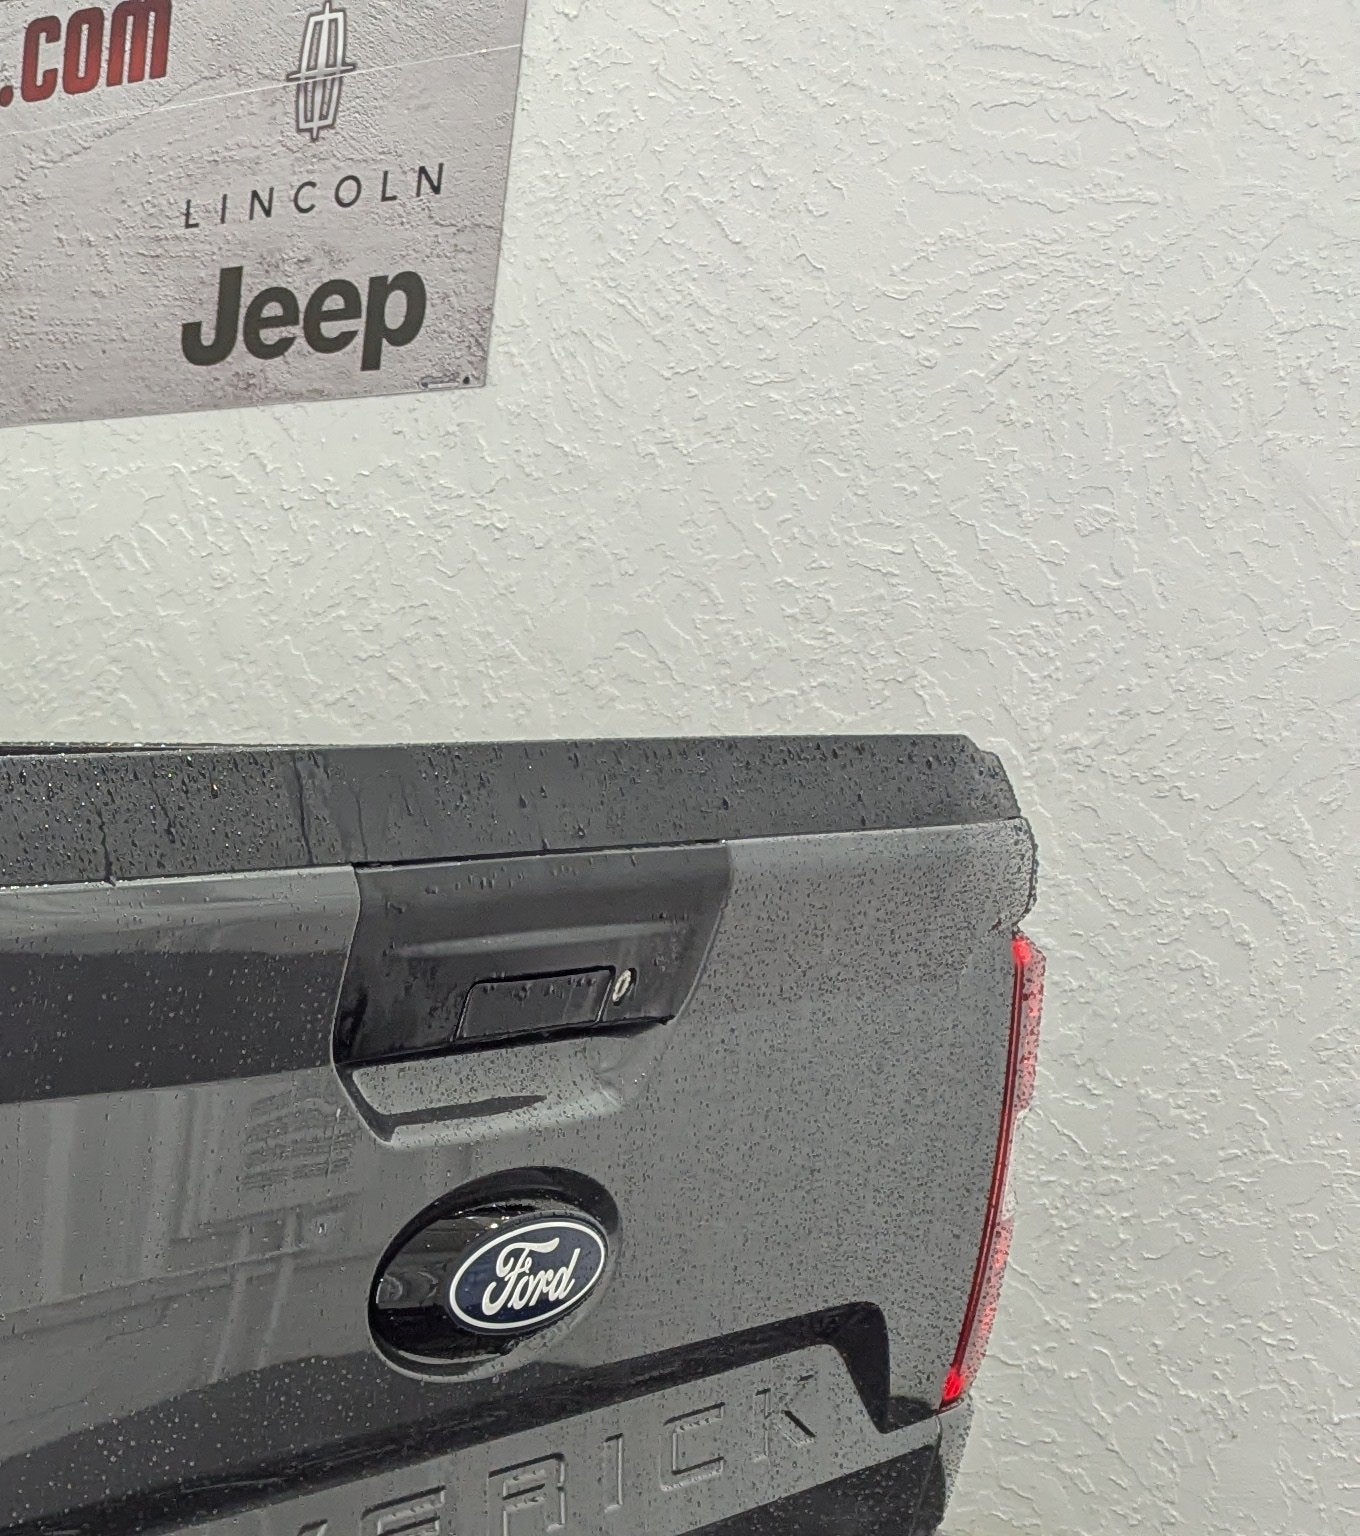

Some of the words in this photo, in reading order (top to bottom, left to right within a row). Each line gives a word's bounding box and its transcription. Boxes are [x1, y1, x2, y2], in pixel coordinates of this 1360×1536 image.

[184, 162, 444, 228] LINCOLN
[181, 266, 427, 371] Jeep
[481, 1236, 582, 1317] Ford
